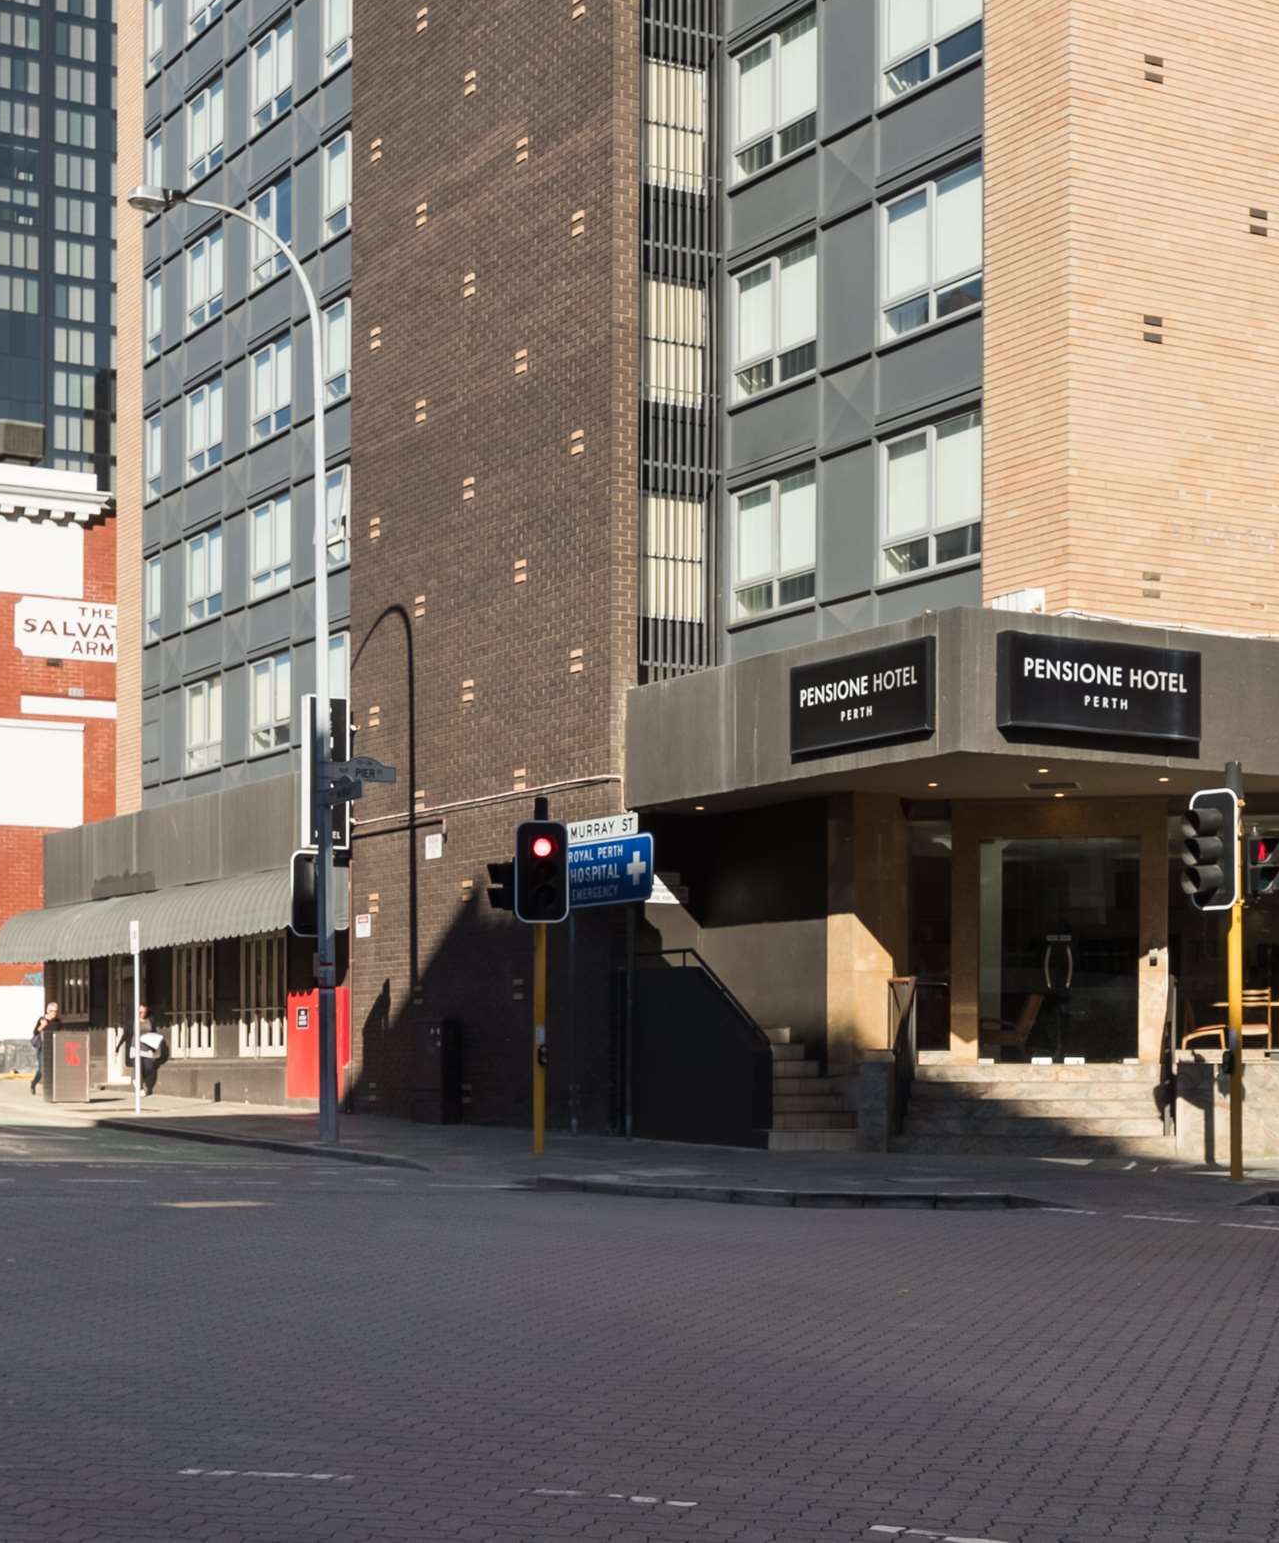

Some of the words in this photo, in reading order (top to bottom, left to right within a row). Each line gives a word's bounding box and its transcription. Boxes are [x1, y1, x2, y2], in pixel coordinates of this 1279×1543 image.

[79, 607, 113, 619] THE
[24, 618, 116, 639] SALVA
[72, 641, 114, 656] ARM
[1023, 657, 1123, 687] PENSIONE
[1129, 668, 1187, 694] HOTEL
[799, 675, 869, 708] PENSIONE
[872, 665, 917, 693] HOTEL
[1084, 695, 1128, 711] PERTH
[840, 706, 873, 722] PERTH
[570, 821, 615, 839] MURRAY
[622, 818, 633, 832] ST
[568, 849, 594, 864] ROYAL
[597, 845, 624, 859] PERTH
[569, 863, 620, 883] HOSPITAL
